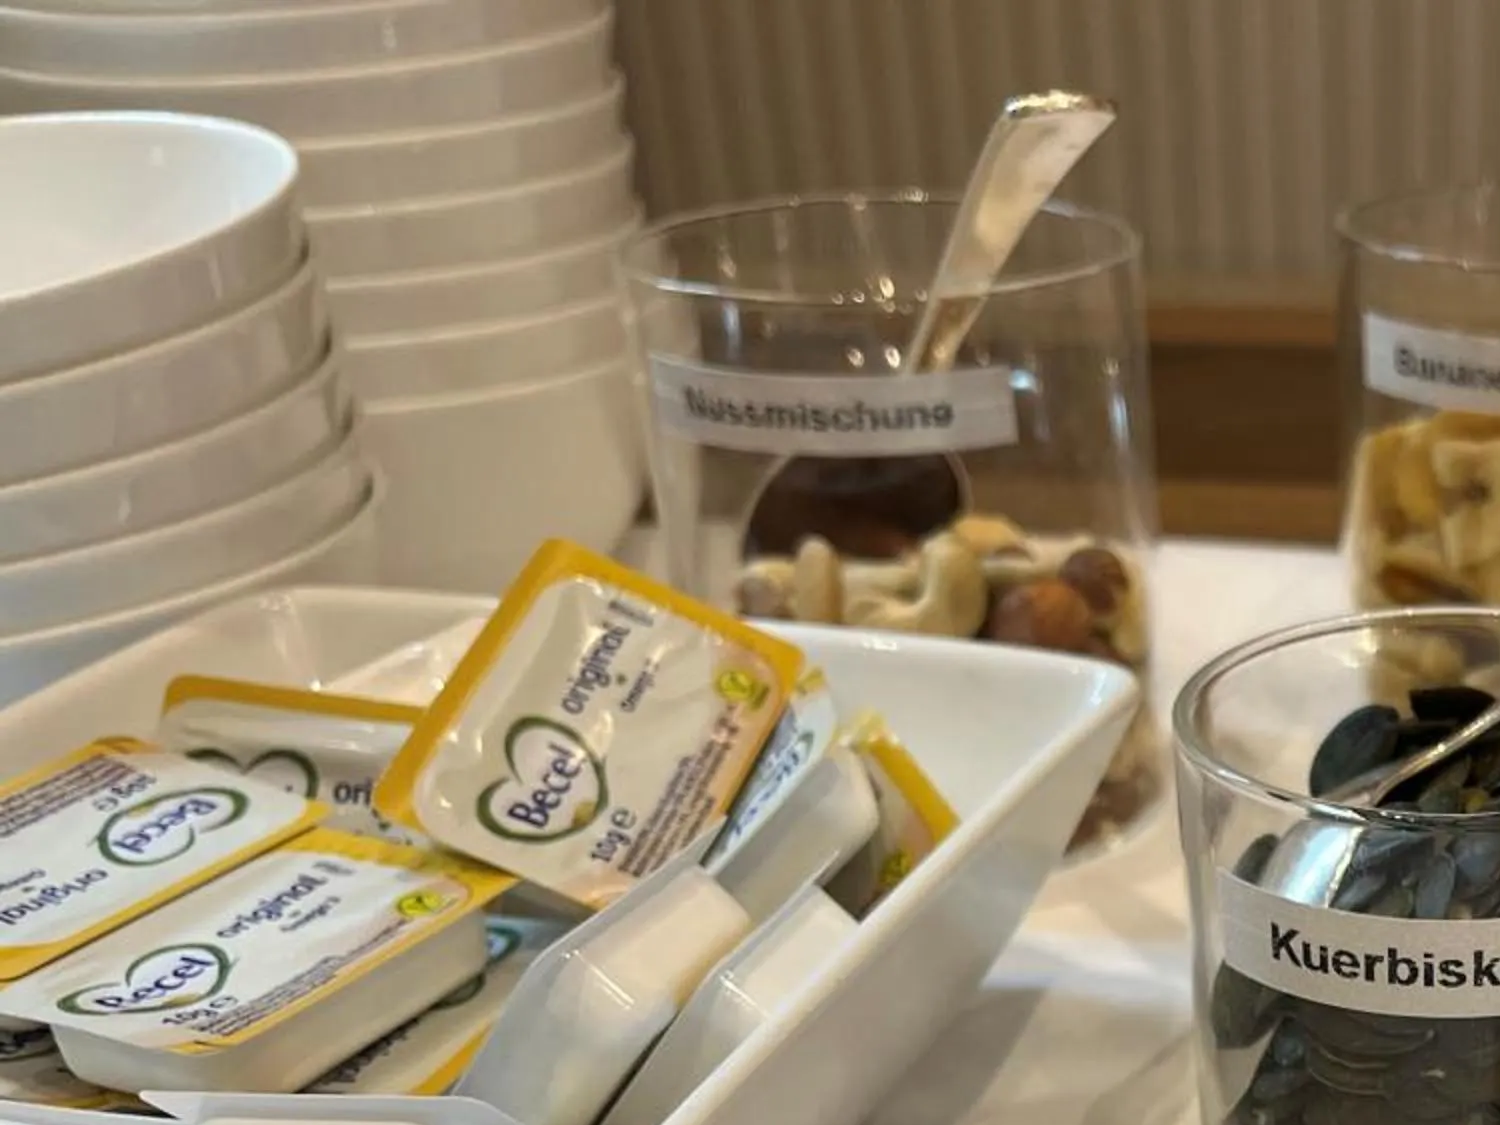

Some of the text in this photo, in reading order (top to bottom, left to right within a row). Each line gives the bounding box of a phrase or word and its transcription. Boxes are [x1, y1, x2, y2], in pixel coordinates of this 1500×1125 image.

[684, 384, 955, 432] Nussmischung
[561, 620, 630, 715] original
[507, 741, 586, 829] Becel
[112, 799, 218, 854] Becel
[216, 874, 328, 939] original
[96, 956, 216, 1008] Becel
